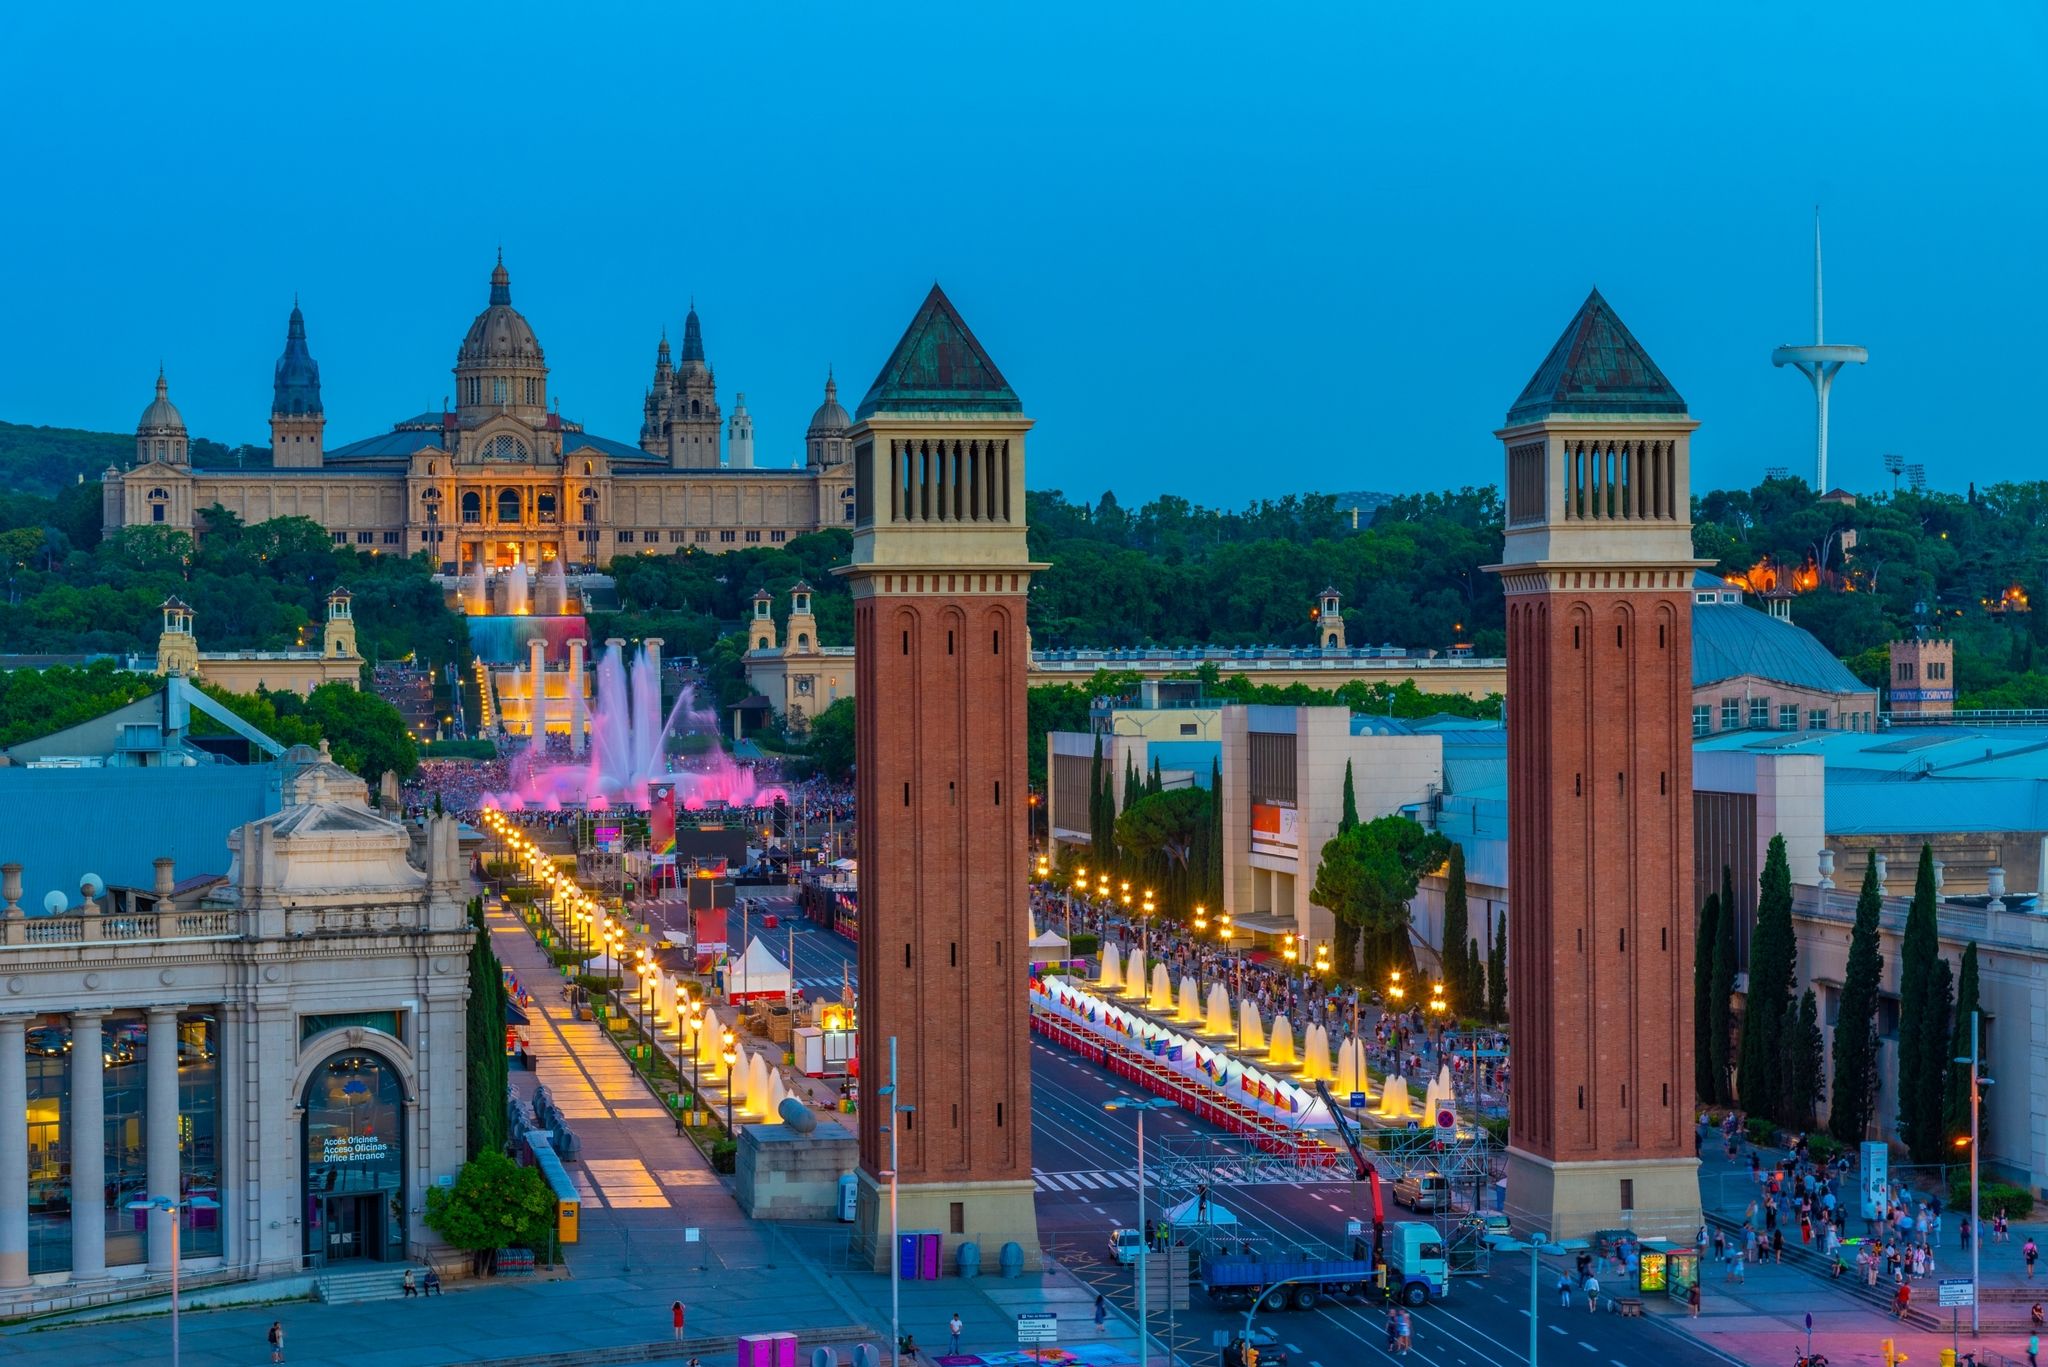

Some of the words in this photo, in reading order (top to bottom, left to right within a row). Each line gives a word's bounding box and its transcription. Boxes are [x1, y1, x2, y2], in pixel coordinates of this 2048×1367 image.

[323, 1136, 346, 1146] Accés
[347, 1136, 378, 1144] Oficines
[323, 1146, 353, 1154] Acceso
[354, 1143, 388, 1152] Oficinas
[323, 1154, 348, 1163] Office
[349, 1152, 385, 1161] Entrance
